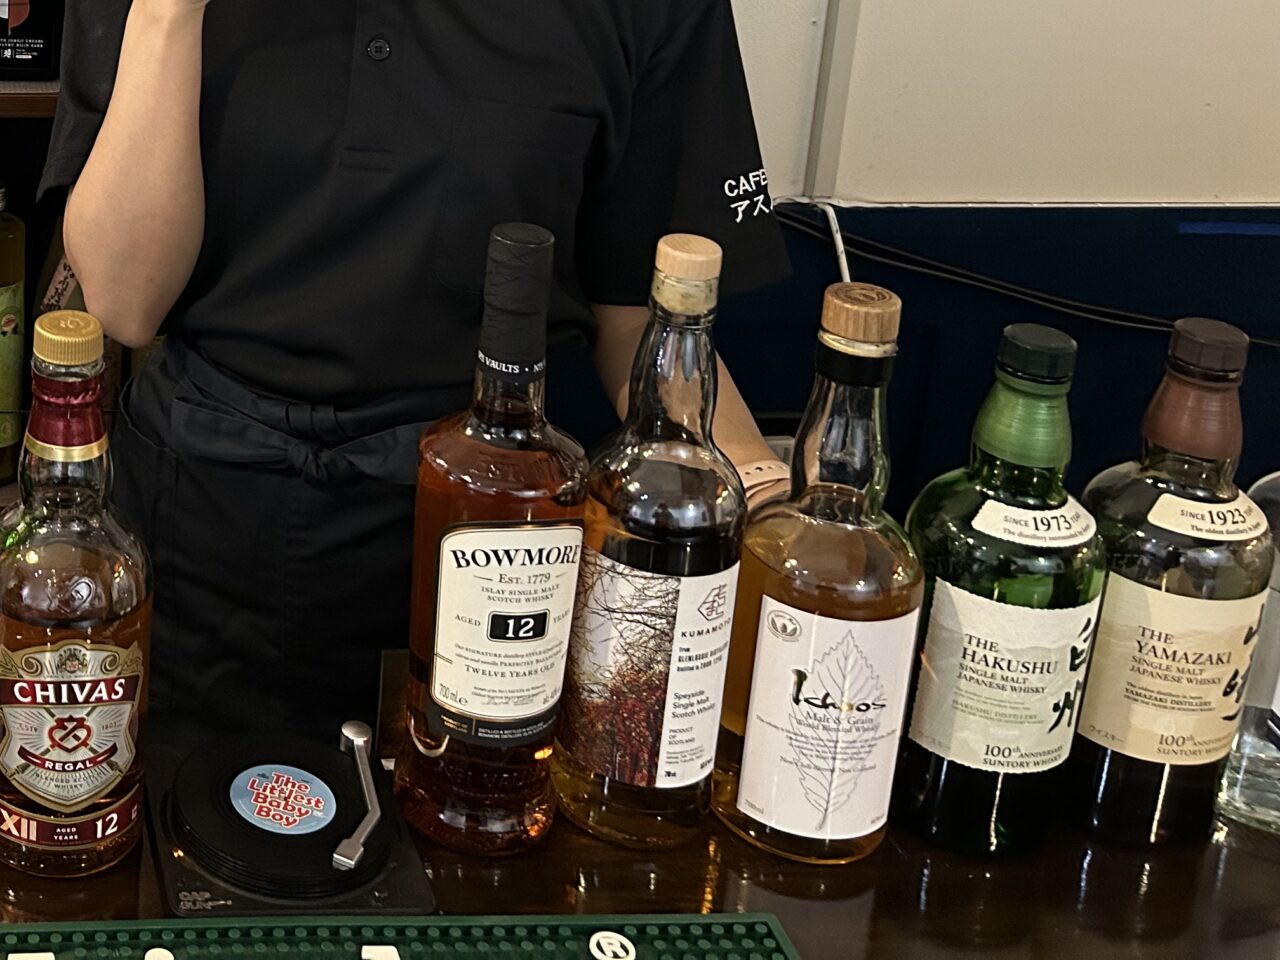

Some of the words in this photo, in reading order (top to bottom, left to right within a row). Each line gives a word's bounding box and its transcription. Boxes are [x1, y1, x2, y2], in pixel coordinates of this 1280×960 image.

[730, 195, 769, 223] アス
[485, 356, 519, 373] VAULTS
[1003, 515, 1030, 527] SINCE
[1032, 515, 1071, 532] 1973
[1180, 509, 1206, 520] SINCE
[1208, 509, 1246, 526] 1923
[450, 544, 580, 569] BOWMORE
[528, 573, 550, 584] 1779
[482, 586, 505, 595] ISLAY
[541, 584, 559, 593] MALT
[525, 593, 553, 602] WHISKY
[455, 614, 481, 626] AGED
[506, 618, 535, 638] 12
[681, 617, 731, 638] KUMAMOTO
[965, 634, 999, 652] THE
[1138, 626, 1174, 644] THE
[961, 647, 1058, 674] HAKUSHU
[1136, 640, 1232, 665] YAMAZAKI
[959, 663, 996, 680] SINGLE
[1000, 673, 1028, 684] MALT
[1129, 665, 1183, 683] JAPANESE
[1132, 656, 1171, 672] SINGLE
[1176, 667, 1205, 675] MALT
[13, 679, 126, 704] CHIVAS
[957, 672, 1007, 692] JAPANESE
[1010, 685, 1047, 693] WHISKY
[1125, 688, 1168, 703] YAMAZAKI
[673, 700, 695, 710] Single
[671, 710, 696, 719] Scotch
[805, 711, 829, 721] Malt
[847, 716, 874, 724] Grain
[1157, 747, 1203, 757] SUNTORY
[45, 759, 93, 771] REGAL
[983, 758, 1030, 767] SUNTORY
[272, 772, 310, 792] The
[248, 778, 324, 809] Littlest
[252, 791, 311, 818] Baby
[0, 807, 37, 842] XII
[255, 805, 299, 828] Boy
[96, 813, 118, 839] 12
